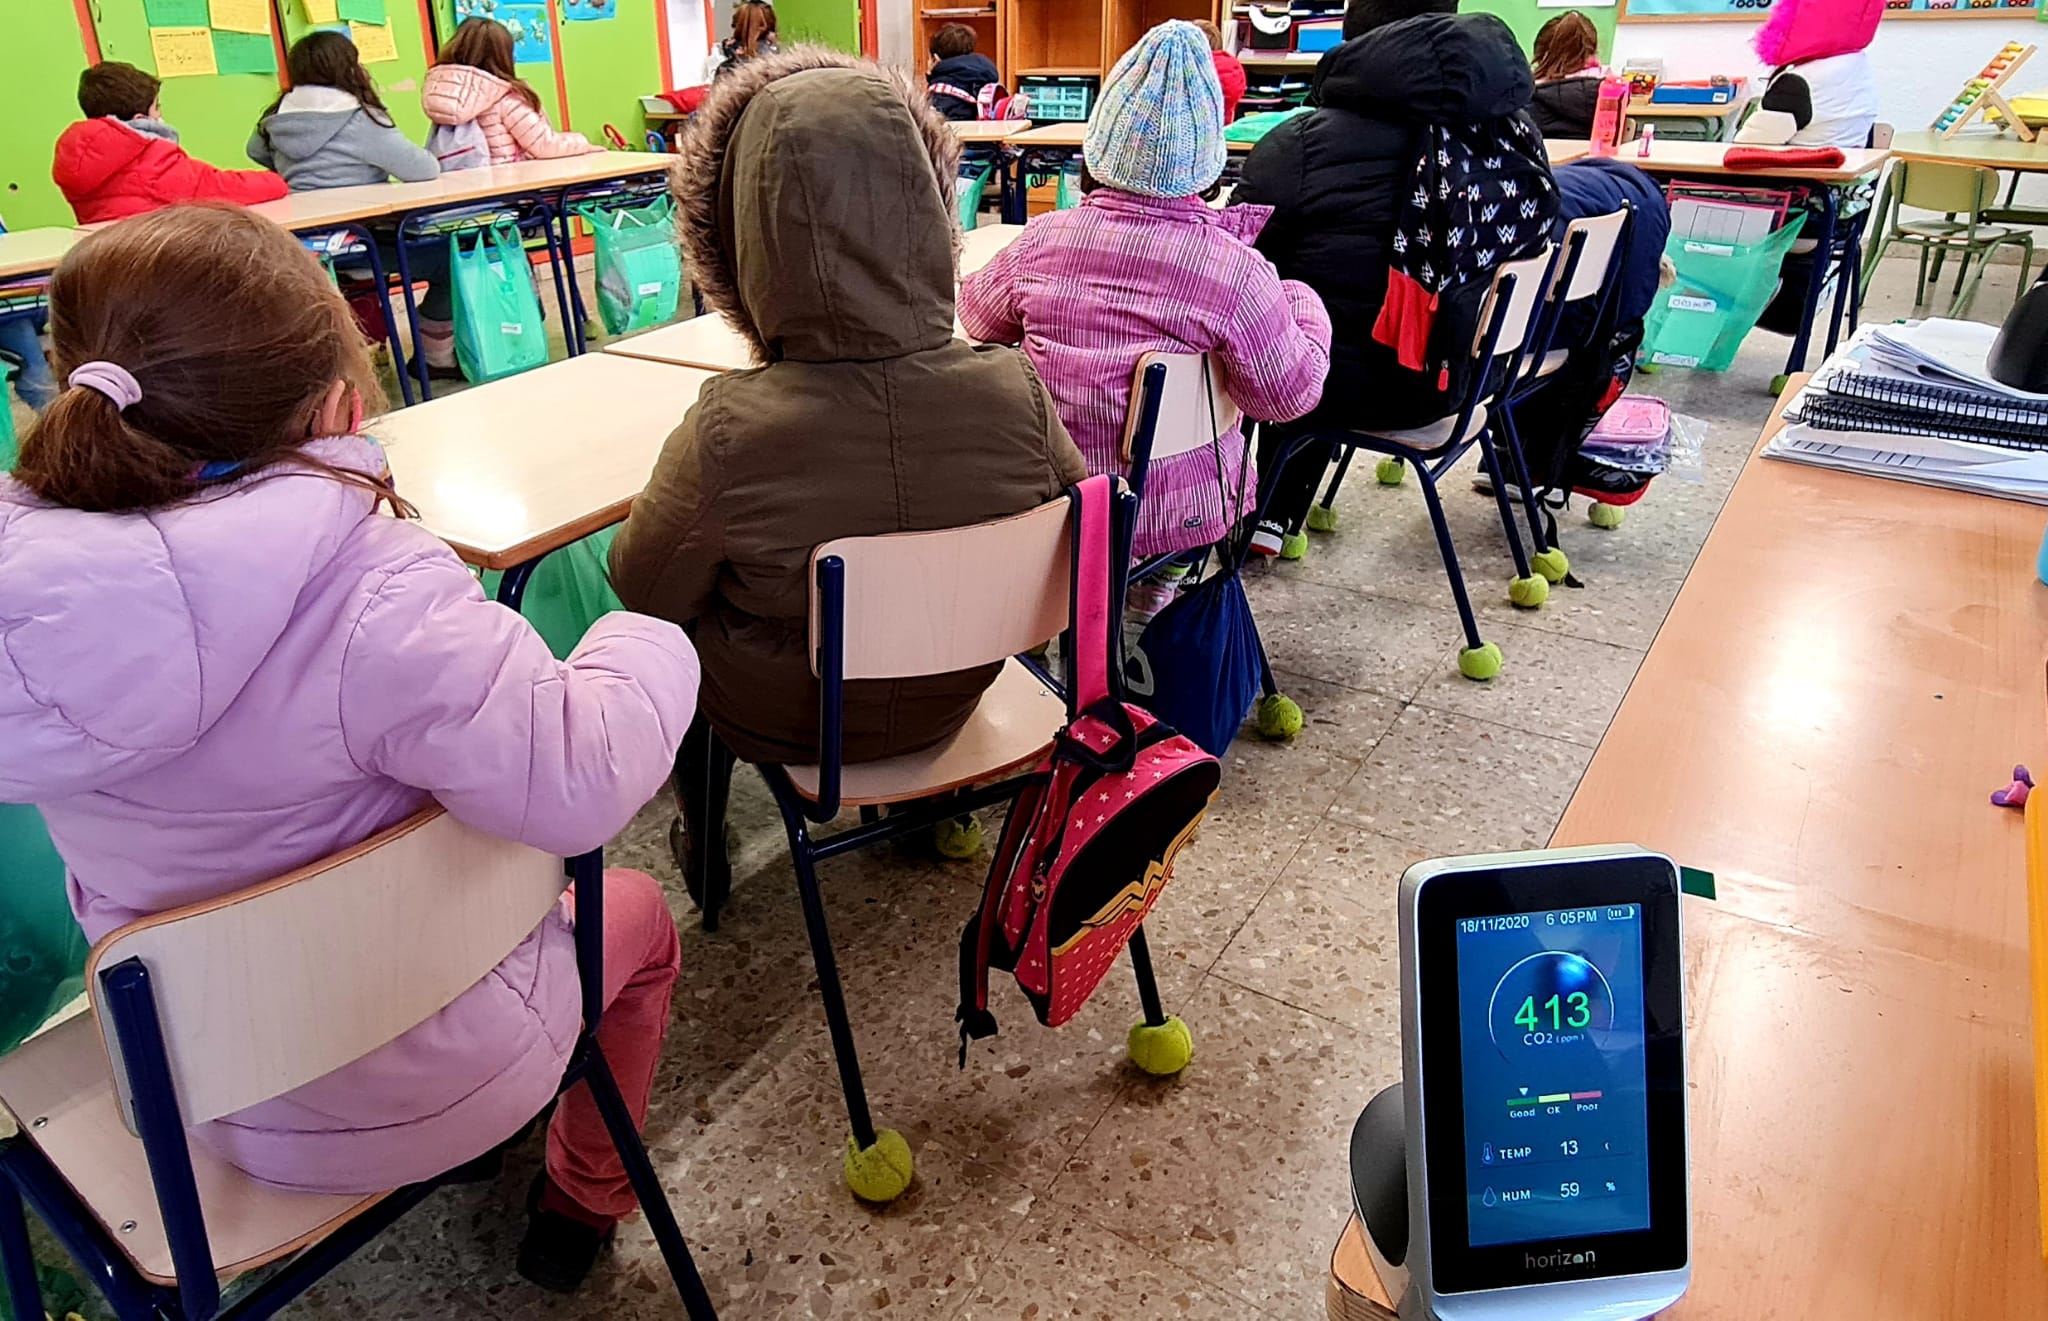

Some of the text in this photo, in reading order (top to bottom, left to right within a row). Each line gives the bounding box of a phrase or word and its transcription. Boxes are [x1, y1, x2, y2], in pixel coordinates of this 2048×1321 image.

[1460, 915, 1529, 933] 18/11/2020
[1513, 991, 1591, 1032] 413
[1523, 1032, 1553, 1046] CO2
[1509, 1103, 1598, 1118] Good OK Poor
[1499, 1147, 1532, 1160] TEMP
[1560, 1139, 1579, 1155] 13
[1502, 1189, 1531, 1202] HUM
[1560, 1182, 1580, 1198] 59
[1525, 1248, 1596, 1269] horizon
